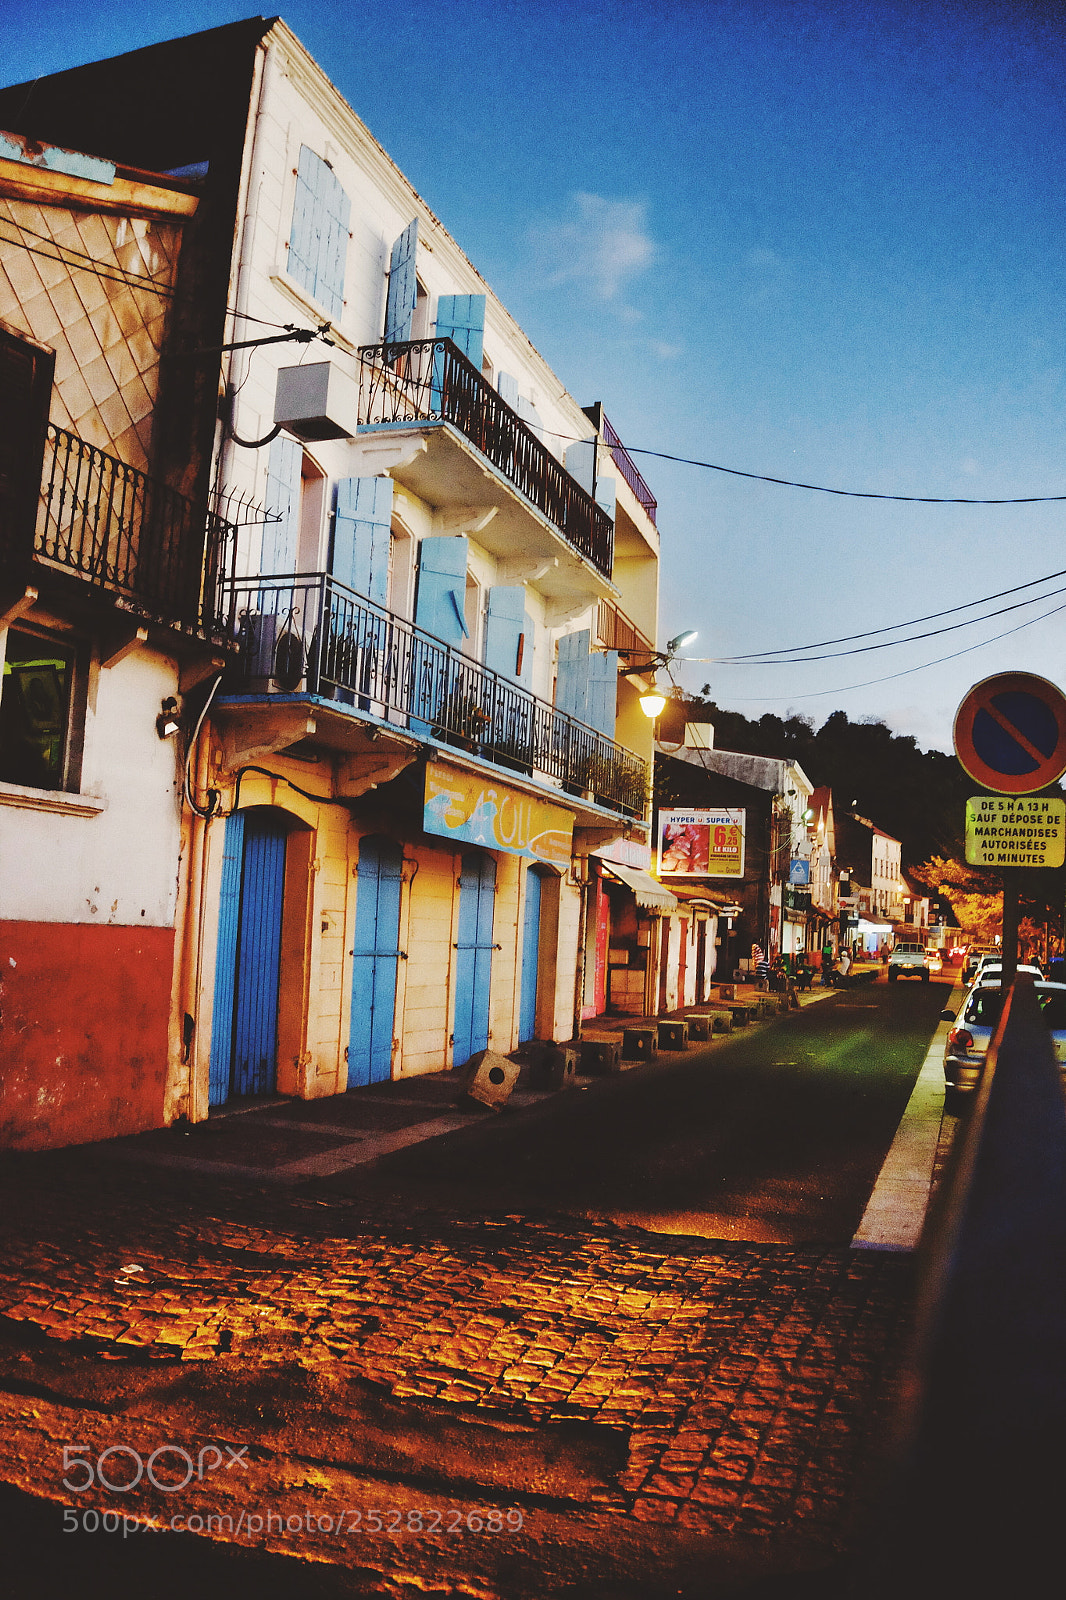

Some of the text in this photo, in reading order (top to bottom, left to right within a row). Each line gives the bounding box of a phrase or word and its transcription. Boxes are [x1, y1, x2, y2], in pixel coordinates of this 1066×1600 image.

[981, 801, 994, 810] DE
[998, 802, 1004, 811] 5
[1007, 802, 1014, 811] H
[1027, 802, 1039, 811] 13
[1042, 803, 1049, 812] H
[970, 813, 1061, 825] SAUF DÉPOSE DE
[714, 825, 726, 847] 6
[974, 827, 1058, 838] MARCHANDISES
[981, 839, 1047, 850] AUTORISÉES
[982, 853, 1045, 863] 10 MINUTES
